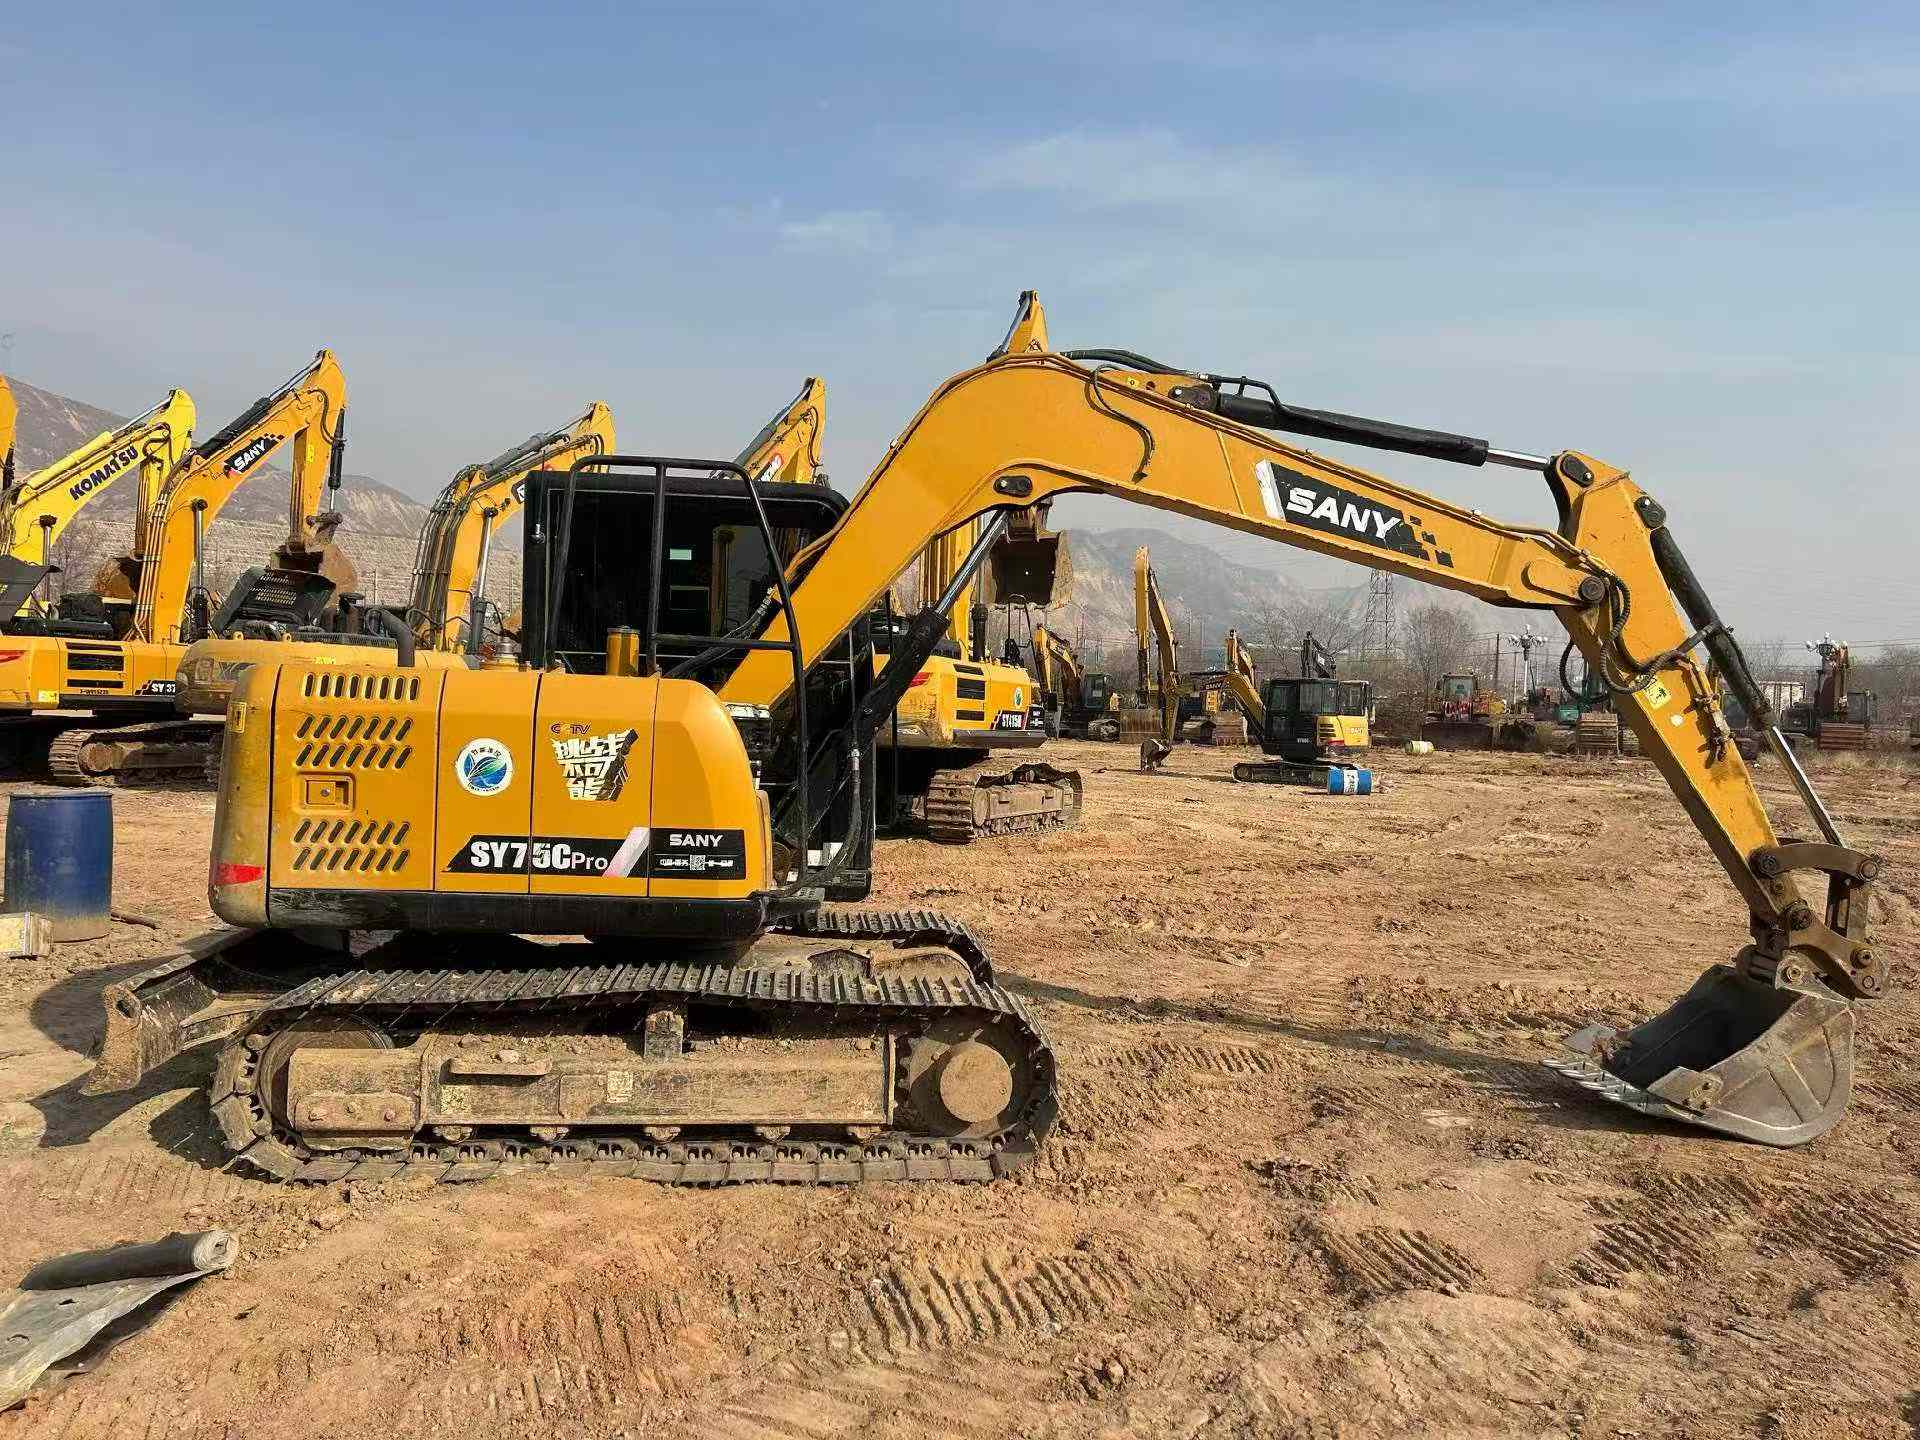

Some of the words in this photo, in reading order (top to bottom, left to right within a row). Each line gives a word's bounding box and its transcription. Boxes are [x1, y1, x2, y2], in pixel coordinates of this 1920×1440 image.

[69, 446, 139, 500] KOMATSU
[233, 439, 267, 472] SANY
[1286, 487, 1401, 540] SANY
[669, 833, 723, 848] SANY
